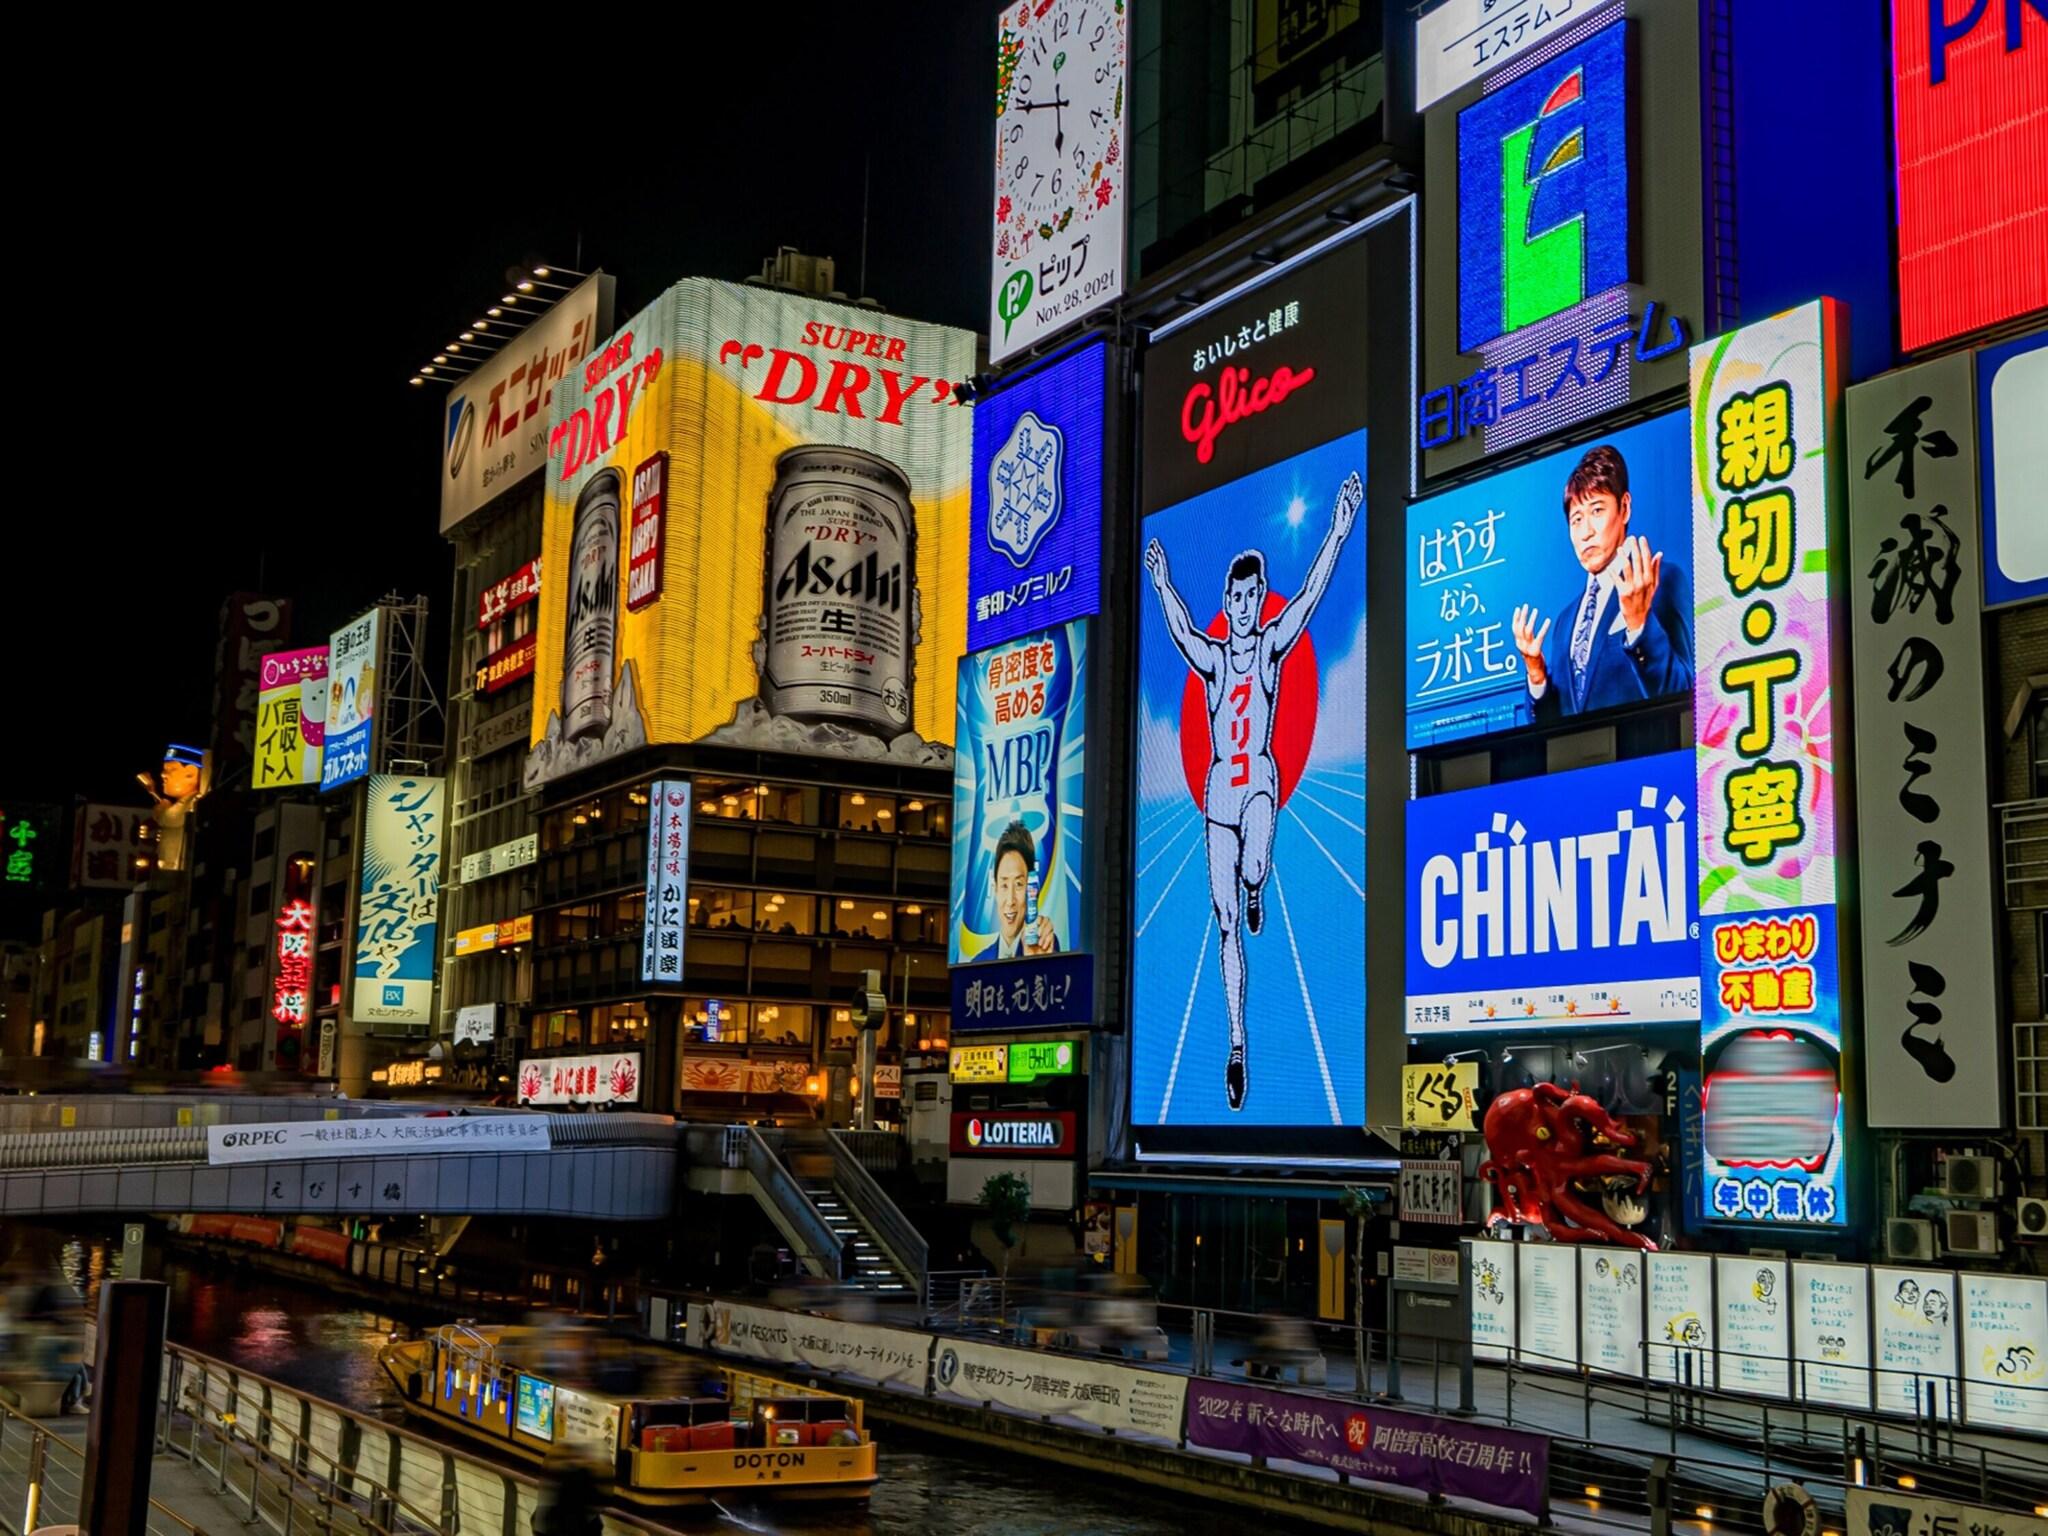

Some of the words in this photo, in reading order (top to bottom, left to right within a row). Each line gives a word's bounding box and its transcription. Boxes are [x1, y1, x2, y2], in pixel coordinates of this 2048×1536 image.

[1052, 12, 1068, 42] 12
[1076, 8, 1086, 35] 1
[1089, 25, 1105, 51] 2
[1031, 36, 1047, 66] 11
[1016, 74, 1033, 108] 10
[1095, 61, 1111, 85] 3
[1010, 124, 1024, 143] 9
[1090, 106, 1103, 128] 4
[1015, 156, 1028, 179] 8
[1073, 143, 1086, 171] 5
[1031, 174, 1044, 198] 7
[1051, 168, 1062, 194] 6
[1038, 234, 1091, 297] ピップ
[1036, 297, 1062, 327] Nov.
[1063, 290, 1083, 317] 28,
[1084, 269, 1117, 302] 2021
[801, 320, 906, 363] SUPER
[1193, 301, 1300, 372] おいしさと健康
[583, 330, 634, 393] SUPER
[1421, 302, 1692, 450] 日商エステム
[1181, 366, 1315, 465] Glico
[633, 459, 662, 508] ASAHI
[632, 514, 658, 560] 1889
[800, 508, 816, 517] THE
[820, 508, 850, 518] JAPAN
[852, 512, 884, 529] BRAND
[827, 516, 859, 528] SUPER
[1418, 509, 1506, 580] はやす
[777, 540, 901, 614] Asahi
[976, 565, 1073, 622] 雪印メグミルク
[820, 609, 857, 636] 生
[1440, 582, 1487, 622] なら、
[1716, 379, 1806, 867] 親切・丁寧
[801, 645, 875, 666] スーパードライ
[988, 641, 1054, 691] 骨密度を
[1415, 621, 1518, 690] ラボモ。
[819, 689, 852, 706] 350ml
[883, 687, 908, 716] お酒
[995, 683, 1045, 726] 高める
[260, 701, 282, 784] バイト
[276, 697, 301, 782] 高収入
[1229, 674, 1253, 788] グリコ
[1864, 396, 1963, 1084] 不滅のミナミ
[986, 728, 1050, 802] MBP
[1420, 790, 1688, 969] CHINTAI
[659, 882, 682, 974] かに道楽
[1715, 915, 1816, 963] ひまわり
[272, 899, 315, 1024] 大阪王将
[1413, 1005, 1451, 1024] 天気予報
[1659, 988, 1699, 1009] 17:48
[1720, 967, 1815, 1014] 不動産
[551, 1064, 598, 1097] かに道楽
[1416, 1072, 1463, 1121] くくる
[222, 1129, 288, 1148] ORPEC
[299, 1126, 388, 1142] 一般社団法人
[984, 1122, 1054, 1144] LOTTERIA
[270, 1180, 402, 1201] えびす橋
[1714, 1177, 1835, 1221] 年中無休
[1198, 1394, 1242, 1425] 2022年
[1247, 1401, 1340, 1441] 新たな時代へ
[1347, 1417, 1366, 1444] 祝
[734, 1452, 806, 1470] DOTON
